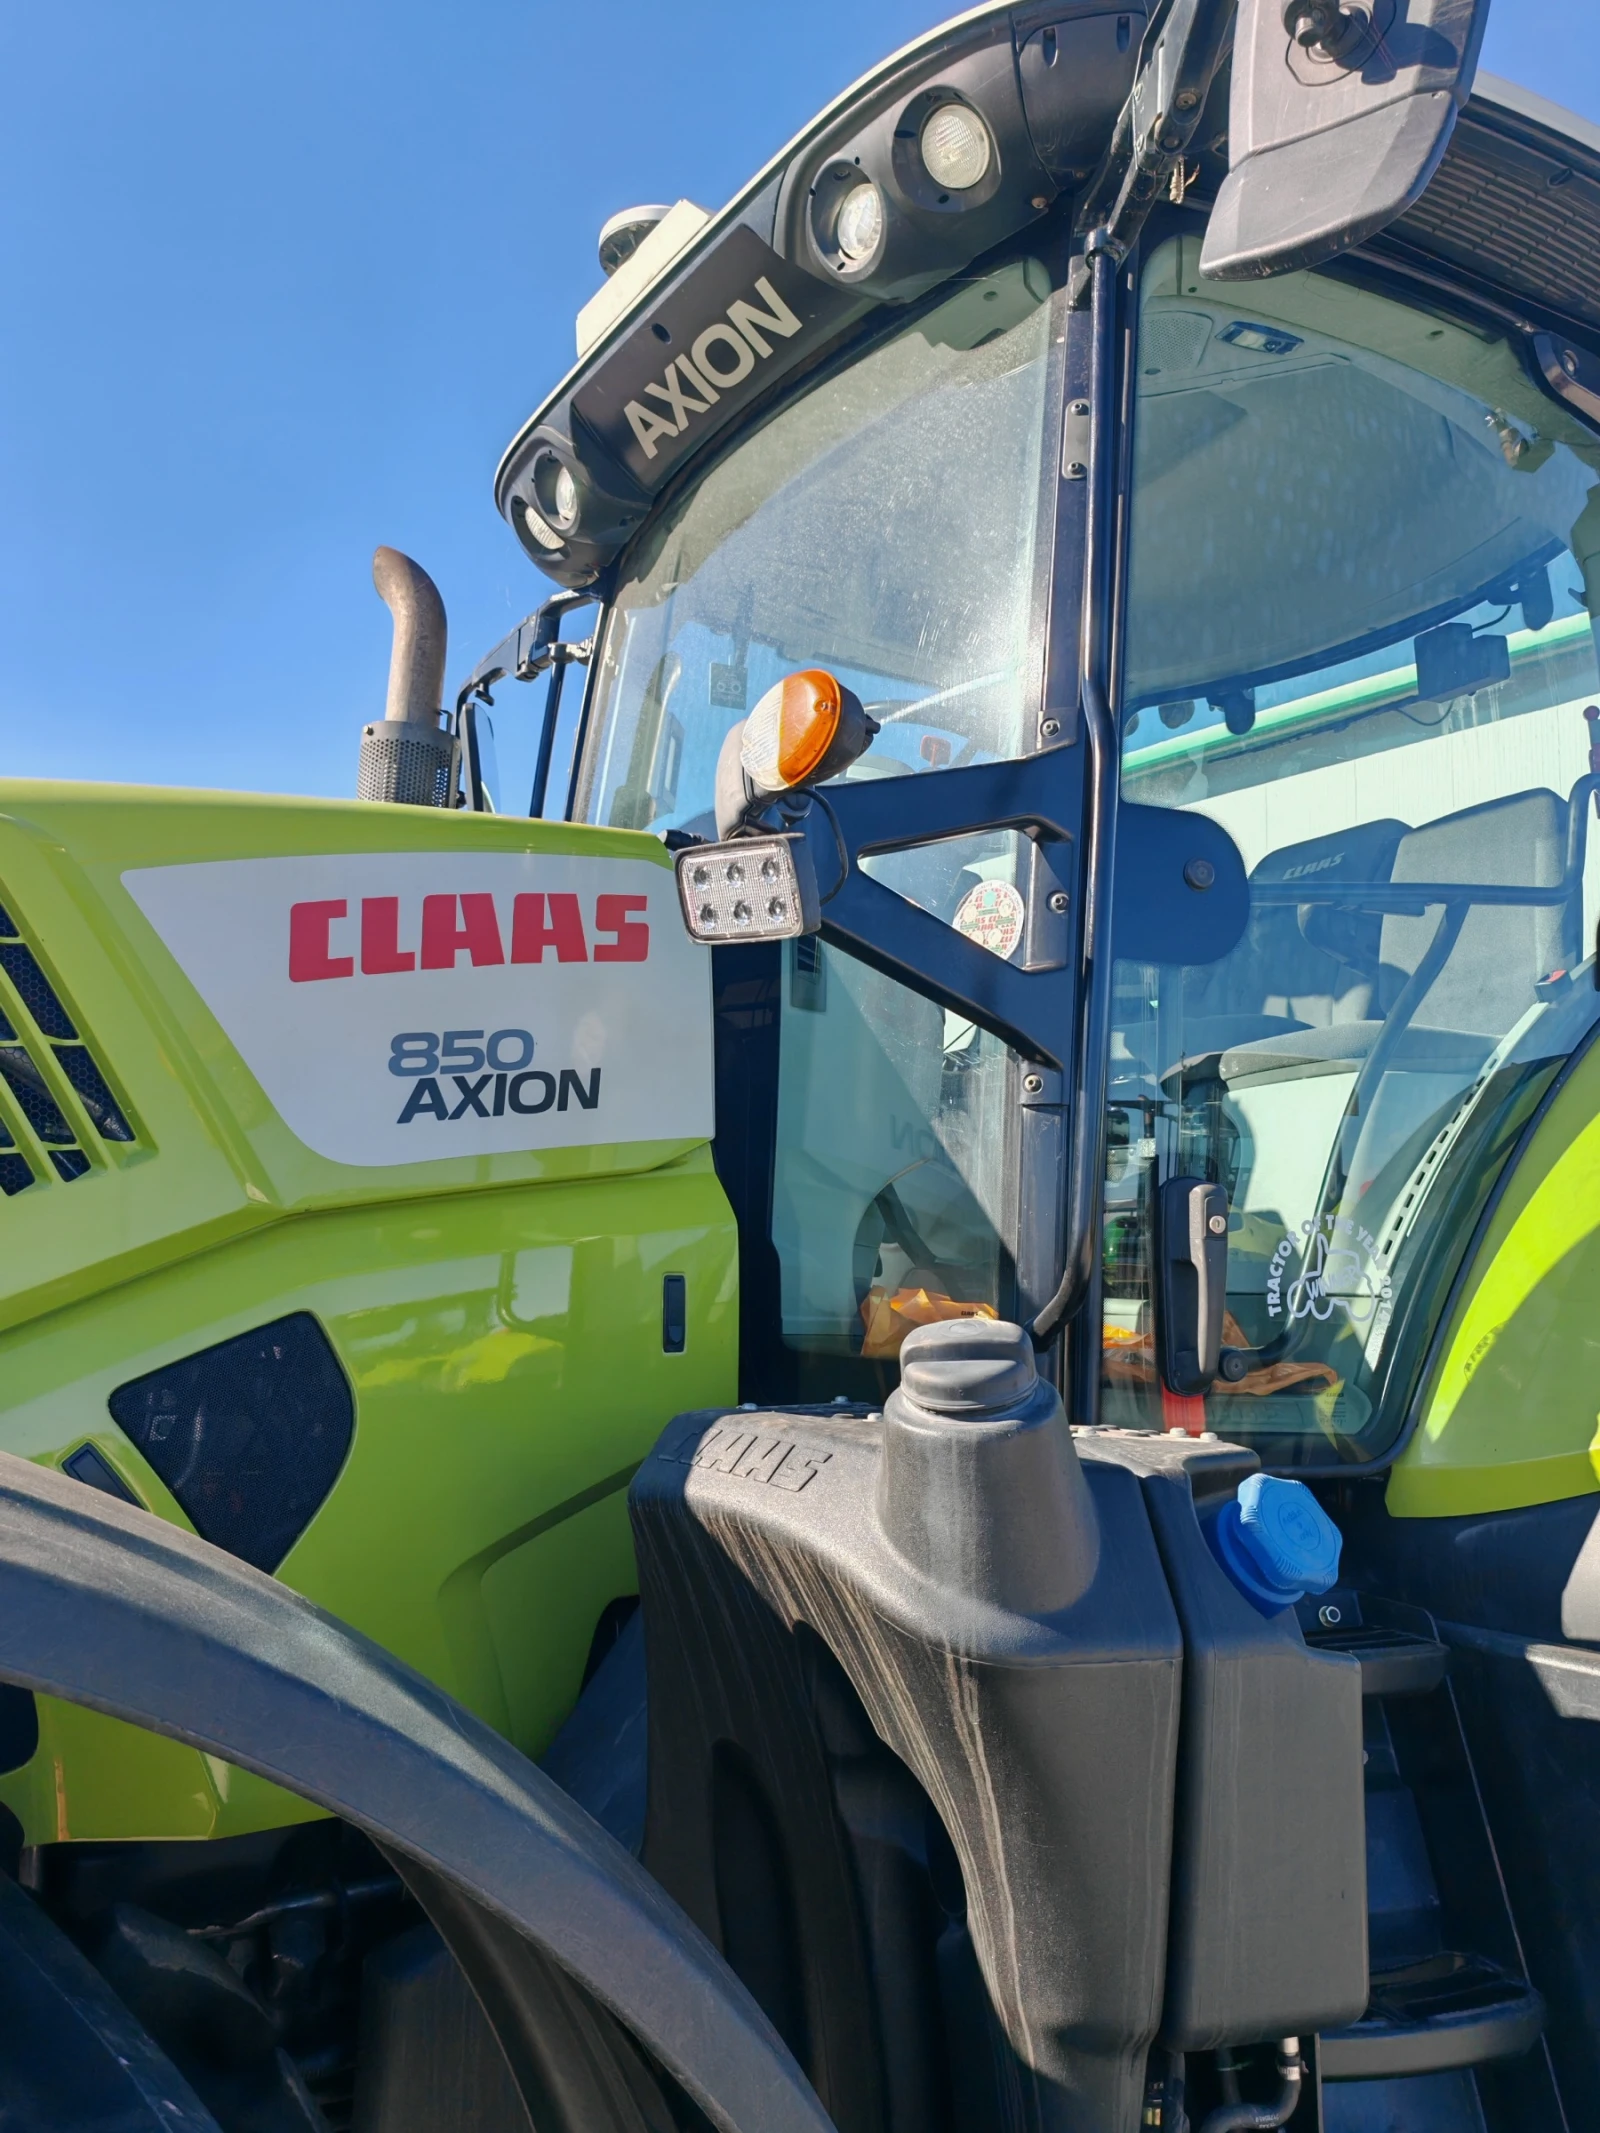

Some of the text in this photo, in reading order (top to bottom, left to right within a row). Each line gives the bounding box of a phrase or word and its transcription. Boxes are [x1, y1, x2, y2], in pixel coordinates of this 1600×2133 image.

[624, 276, 803, 460] AXION
[1282, 852, 1345, 880] CLAAS
[289, 892, 650, 983] CLAAS
[388, 1028, 535, 1077] 850
[396, 1067, 602, 1124] AXION
[1266, 1231, 1301, 1318] TRACTOR
[1301, 1215, 1322, 1236] OF
